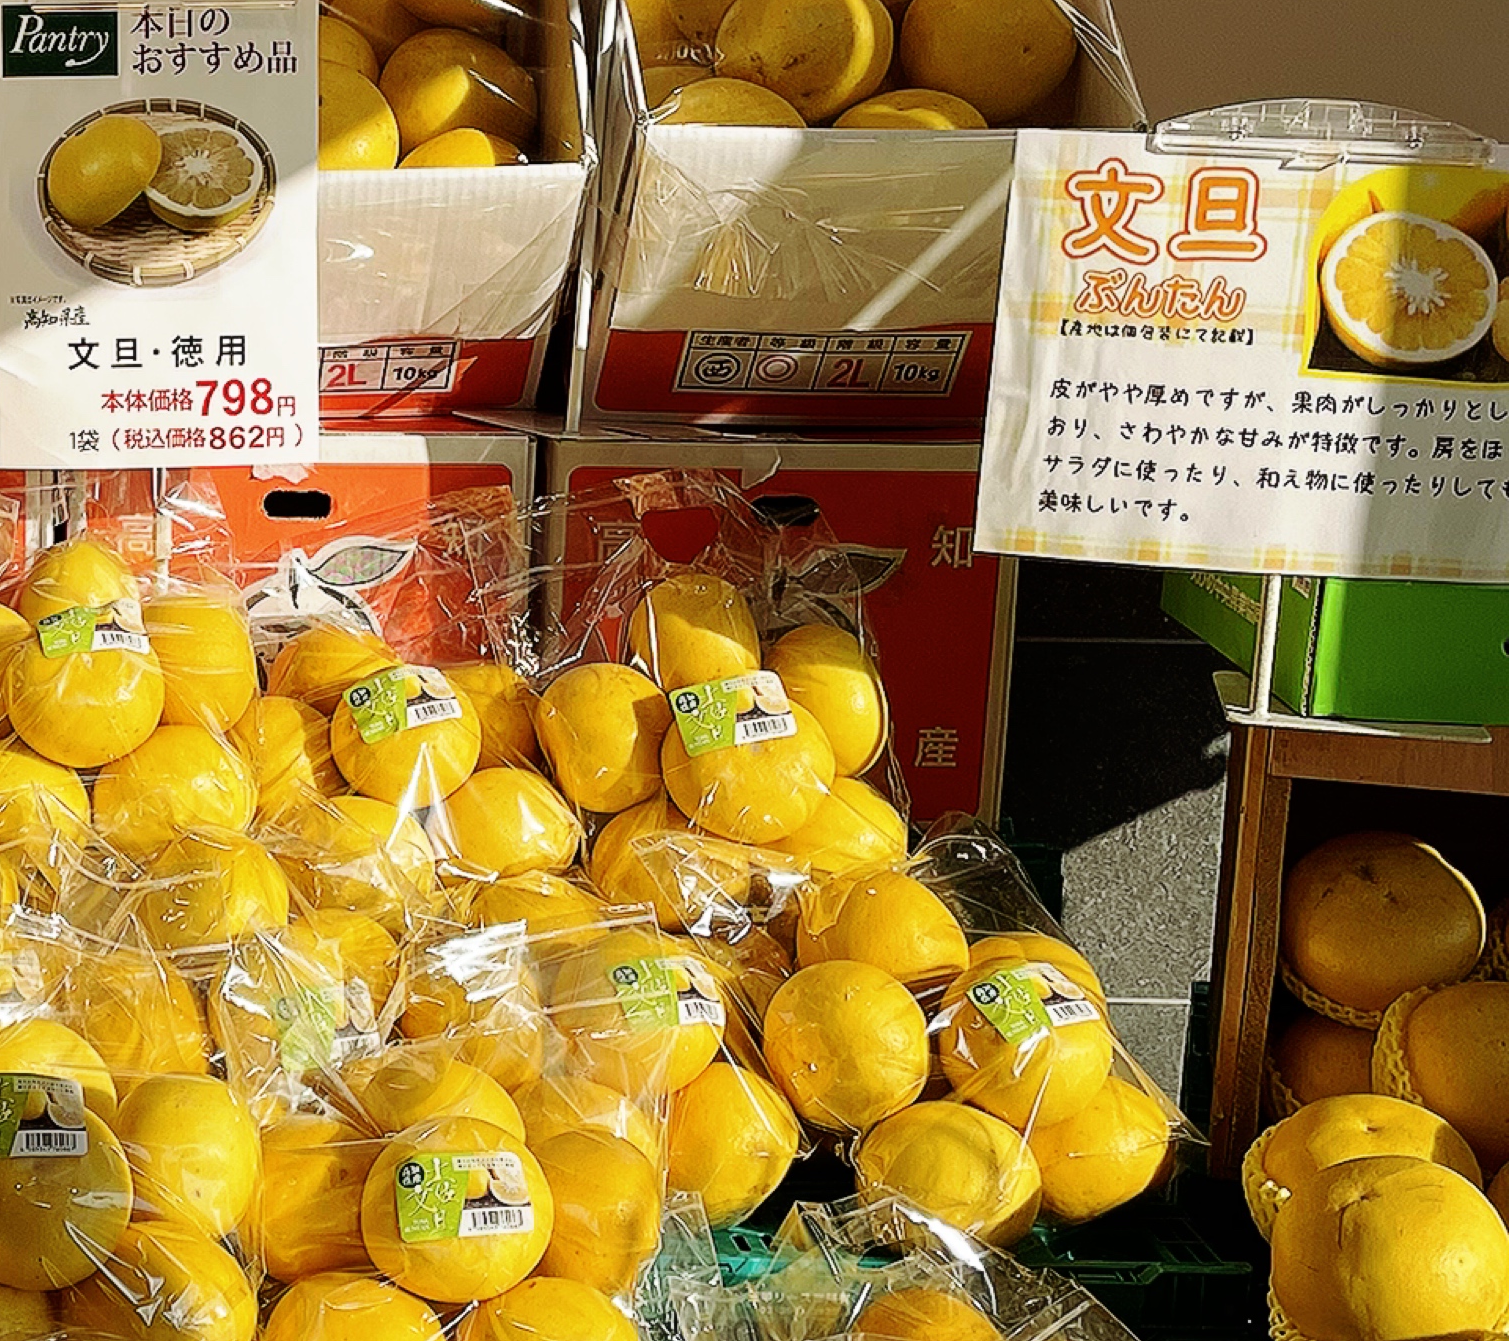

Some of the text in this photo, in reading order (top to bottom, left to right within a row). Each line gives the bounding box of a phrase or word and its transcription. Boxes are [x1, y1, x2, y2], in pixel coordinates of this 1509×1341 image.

[9, 14, 110, 68] Pantry
[131, 6, 230, 39] 本日の
[131, 41, 298, 75] おすすめ品
[1065, 161, 1265, 262] 文旦
[1075, 269, 1246, 322] ぶんたん
[327, 364, 367, 387] 2L
[826, 358, 870, 389] 2L
[893, 362, 940, 382] 10kg
[101, 378, 296, 418] 本体価格798円
[1038, 488, 1190, 522] 美味しいです。
[930, 525, 973, 569] 知
[914, 726, 959, 769] 産
